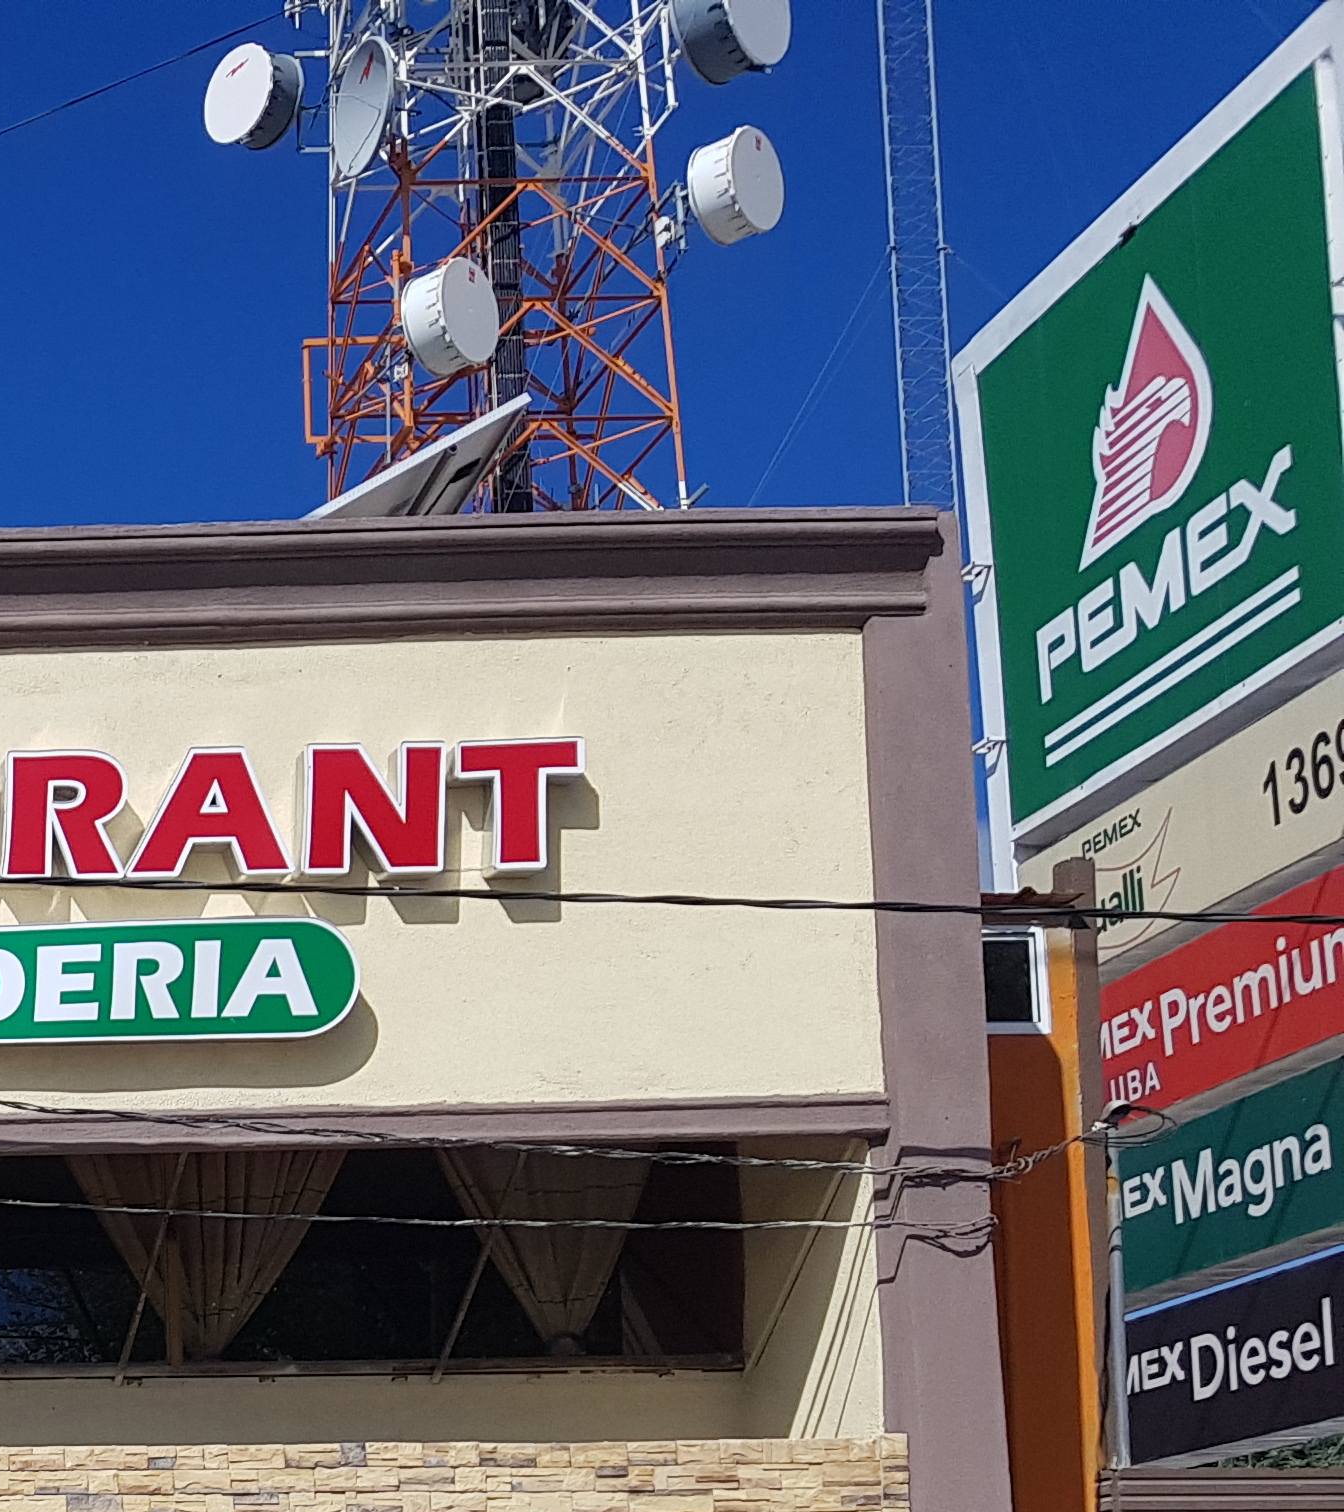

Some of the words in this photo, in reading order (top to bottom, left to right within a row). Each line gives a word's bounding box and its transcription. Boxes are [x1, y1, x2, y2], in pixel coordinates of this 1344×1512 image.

[1036, 443, 1299, 704] PEMEX
[1082, 807, 1142, 861] PEMEX
[1171, 1123, 1333, 1226] Magna
[1190, 1296, 1336, 1402] Diesel
